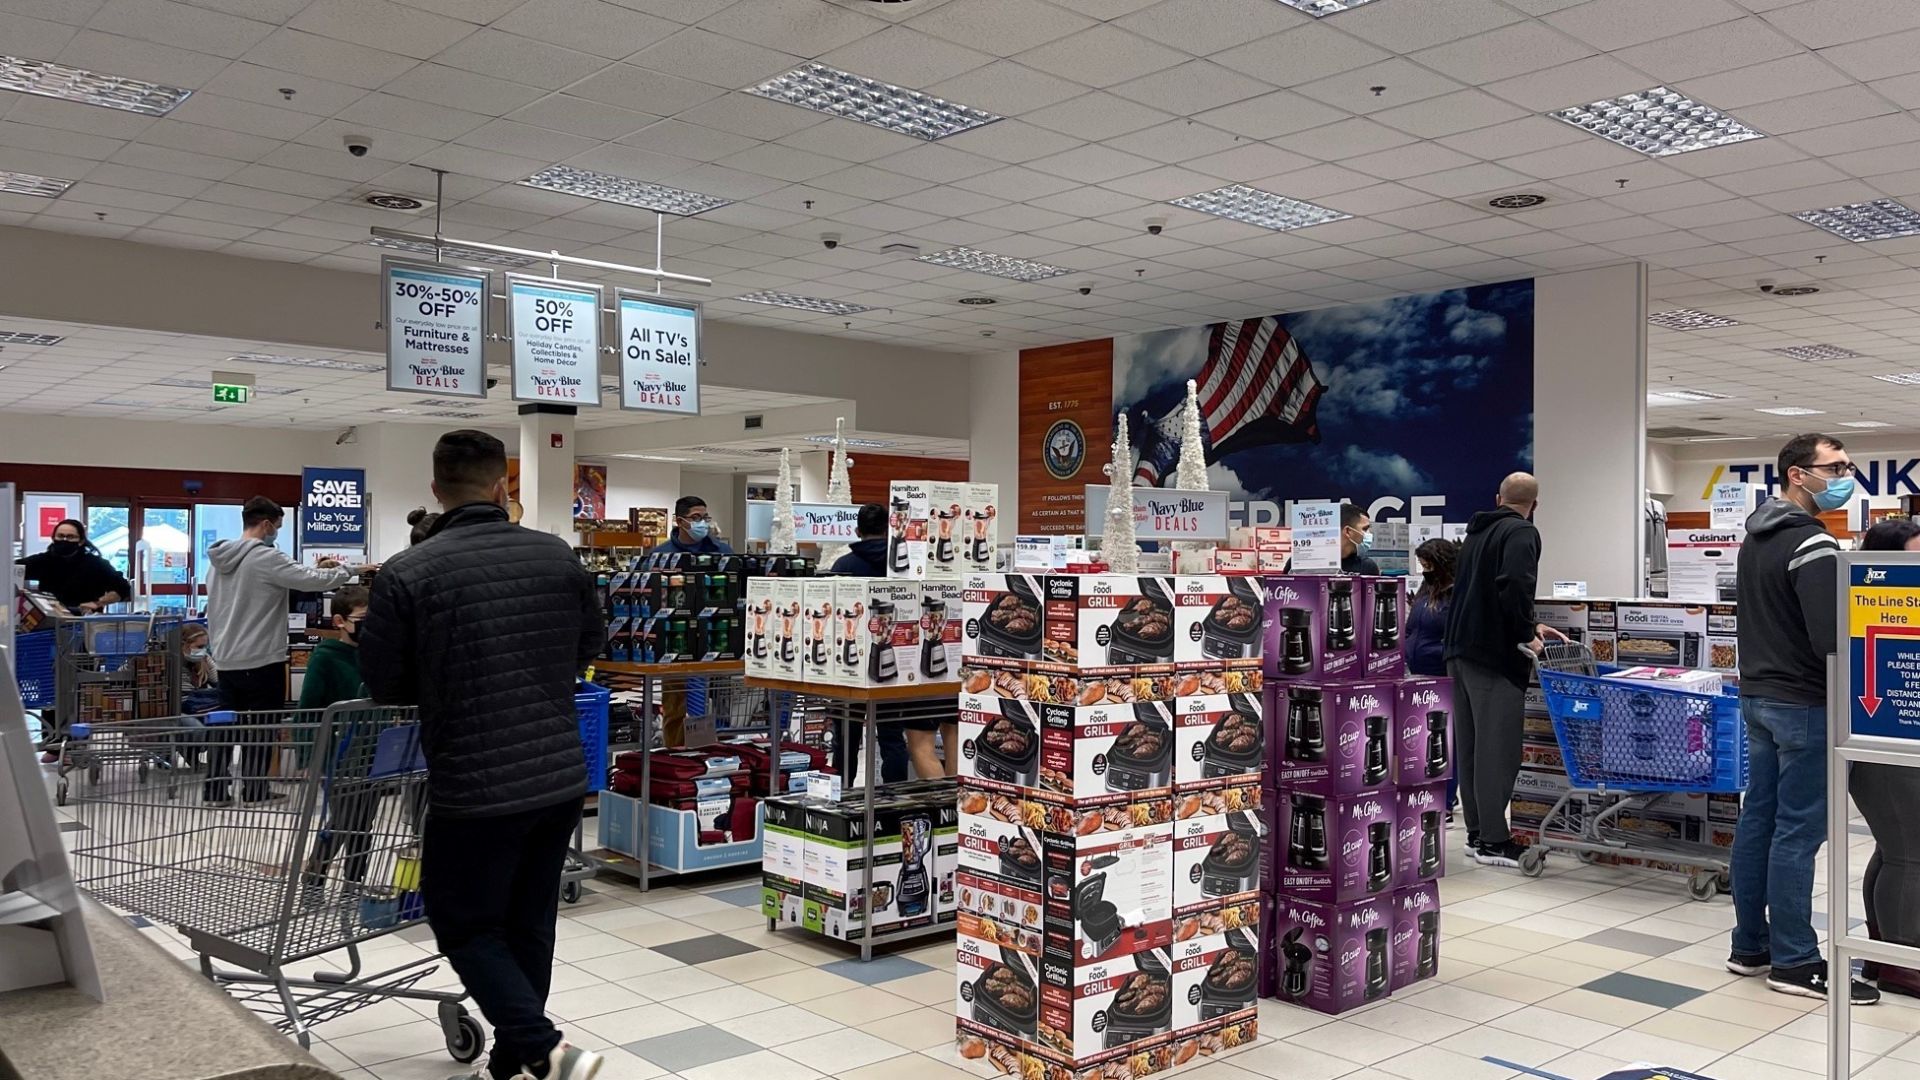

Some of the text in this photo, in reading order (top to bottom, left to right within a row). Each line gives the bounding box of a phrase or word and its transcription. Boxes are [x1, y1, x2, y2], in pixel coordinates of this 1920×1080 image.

[396, 282, 478, 305] 30%-50%
[418, 302, 456, 318] OFF
[536, 299, 574, 317] 50%
[408, 319, 435, 328] everyday
[536, 316, 573, 334] OFF
[404, 326, 470, 342] Furniture &
[630, 327, 688, 348] All TV's
[406, 339, 469, 354] Mattresses
[527, 340, 553, 350] Holiday
[530, 348, 570, 359] Collectibles
[627, 346, 691, 366] On Sale!
[534, 357, 555, 365] Home
[409, 364, 465, 378] Navy Blue
[416, 376, 459, 388] DEALS
[530, 376, 582, 388] Navy Blue
[633, 380, 687, 394] Navy Blue
[538, 386, 576, 398] DEALS
[640, 392, 681, 406] DEALS
[1048, 400, 1080, 410] EST. 1775
[312, 480, 357, 494] SAVE
[891, 484, 920, 493] Hamilton
[308, 494, 362, 508] MORE!
[906, 491, 928, 500] Beach
[1148, 500, 1178, 518] Navy
[1180, 498, 1204, 514] Blue
[314, 512, 356, 522] Use Your
[806, 512, 834, 526] Navy
[834, 510, 858, 522] Blue
[1302, 518, 1329, 526] DEALS
[308, 522, 362, 534] Military Star
[812, 524, 852, 536] DEALS
[1155, 516, 1198, 532] DEALS
[1688, 533, 1737, 543] Cuisinart
[868, 585, 907, 594] Hamilton
[921, 583, 957, 592] Hamilton
[1050, 579, 1074, 588] Cyclonic
[964, 590, 990, 602] GRILL
[1050, 587, 1072, 597] Grilling
[1094, 586, 1112, 594] Foodi
[1274, 586, 1300, 606] Coffee
[890, 592, 917, 601] Beach
[1088, 596, 1118, 608] GRILL
[1182, 594, 1209, 606] GRILL
[1855, 595, 1920, 608] The Line St
[1624, 614, 1649, 622] Foodi
[1880, 612, 1908, 624] Here
[1897, 652, 1920, 660] WHILE
[1888, 661, 1915, 670] PLEASE
[1360, 694, 1380, 714] Coffee
[1422, 690, 1440, 709] Coffee
[1892, 699, 1908, 707] YOU
[965, 702, 982, 710] Foodi
[1189, 704, 1206, 712] Foodi
[960, 710, 987, 724] GRILL
[1046, 708, 1070, 718] Cyclonic
[1090, 714, 1108, 723] Foodi
[1184, 713, 1212, 725] GRILL
[1046, 715, 1068, 726] Grilling
[1084, 724, 1114, 737] GRILL
[1402, 724, 1422, 740] 12 cup
[1339, 730, 1360, 746] 12 cup
[1281, 770, 1292, 780] EASY
[1310, 768, 1329, 776] switch
[1417, 790, 1434, 809] Coffee
[764, 802, 787, 824] NINJA
[1364, 800, 1383, 821] Coffee
[805, 813, 829, 835] NINJA
[850, 820, 882, 838] NIA
[970, 826, 987, 837] Foodi
[1188, 826, 1204, 836] Foodi
[964, 836, 992, 852] GRILL
[1182, 838, 1208, 850] GRILL
[1342, 838, 1364, 856] 12 cup
[1414, 892, 1431, 909] Coffee
[1302, 910, 1326, 929] Coffee
[1361, 907, 1380, 929] Coffee
[962, 942, 980, 954] Foodi
[1185, 946, 1202, 956] Foodi
[957, 951, 984, 969] GRILL
[1340, 946, 1362, 966] 12 cup
[1180, 956, 1208, 970] GRILL
[1088, 971, 1108, 982] Foodi
[1083, 982, 1114, 996] GRILL
